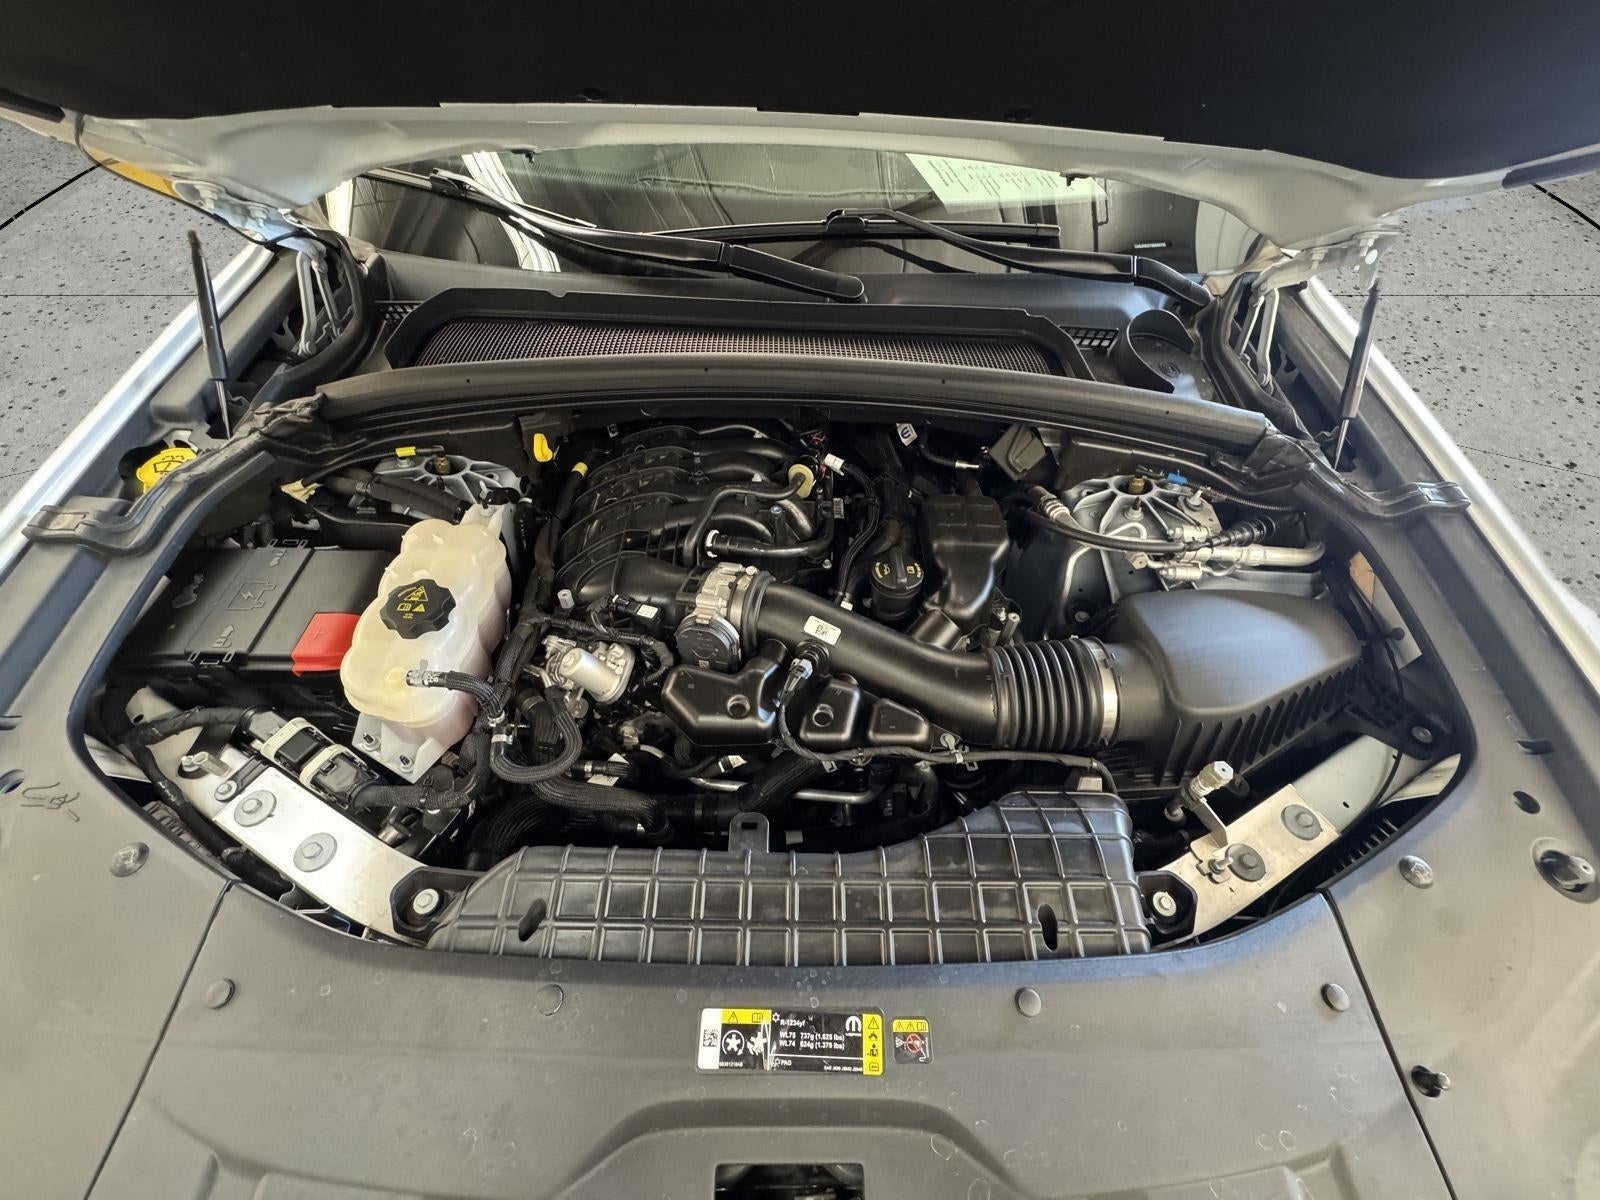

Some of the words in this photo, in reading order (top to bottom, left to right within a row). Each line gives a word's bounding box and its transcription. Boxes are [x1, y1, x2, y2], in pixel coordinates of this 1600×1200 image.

[780, 1019, 806, 1027] R-1234yf
[780, 1031, 796, 1039] WL75
[800, 1032, 814, 1040] 737g
[834, 1034, 844, 1042] lbs)
[834, 1042, 844, 1050] lbs)
